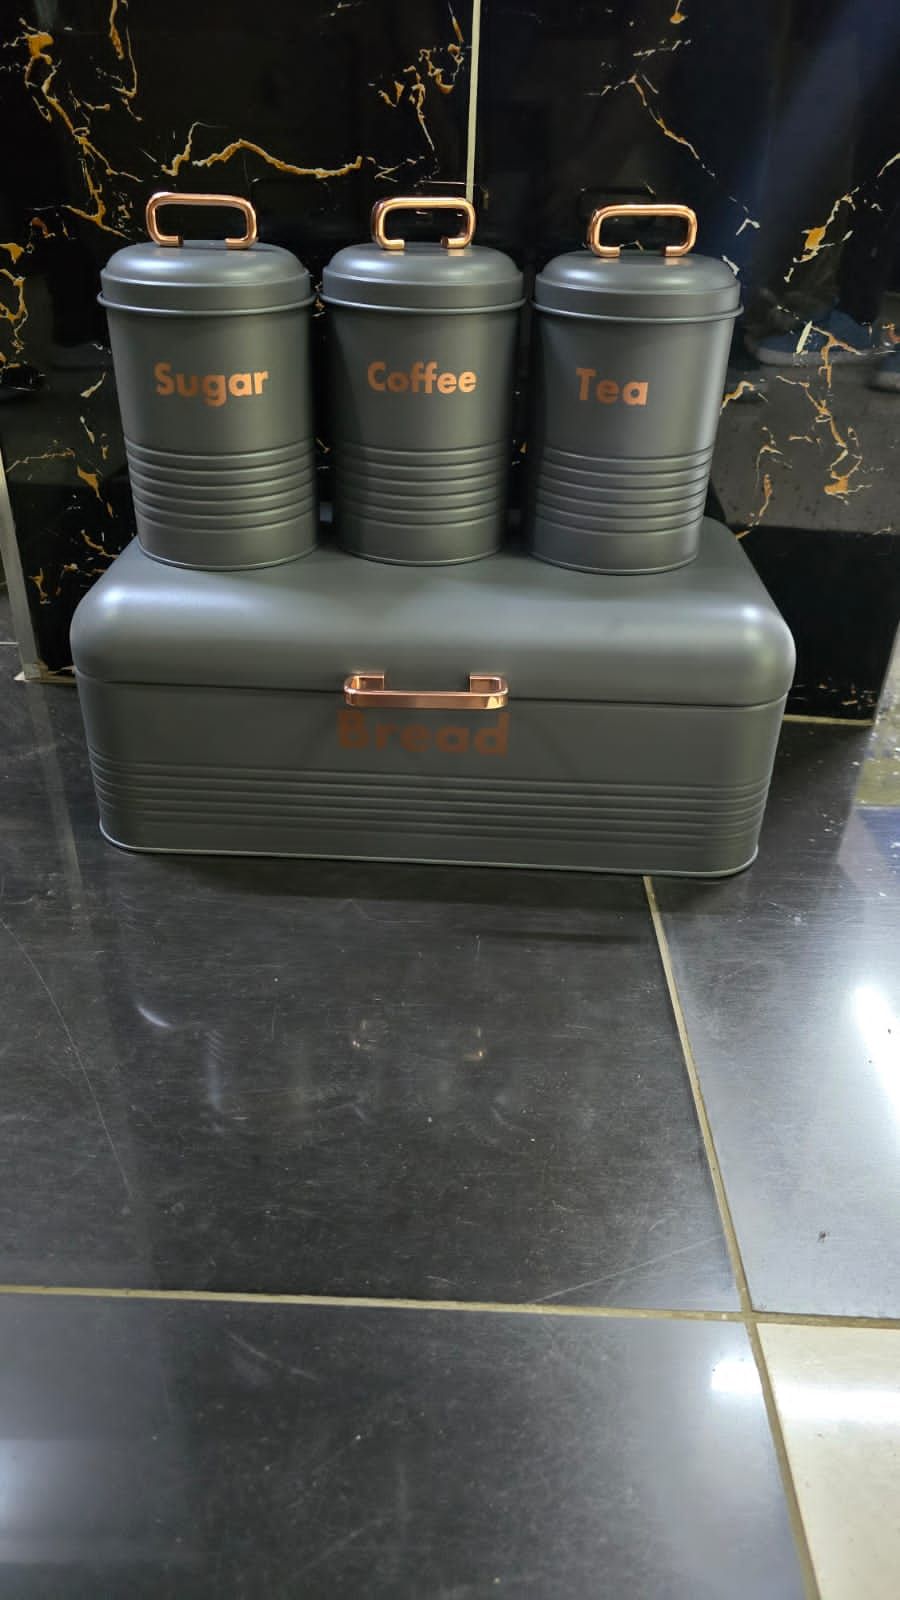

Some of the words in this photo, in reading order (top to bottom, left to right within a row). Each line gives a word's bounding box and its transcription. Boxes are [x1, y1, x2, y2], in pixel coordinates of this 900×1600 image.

[154, 362, 270, 407] Sugar
[367, 360, 478, 395] Coffee
[576, 367, 649, 406] Tea
[337, 710, 510, 756] Bread
